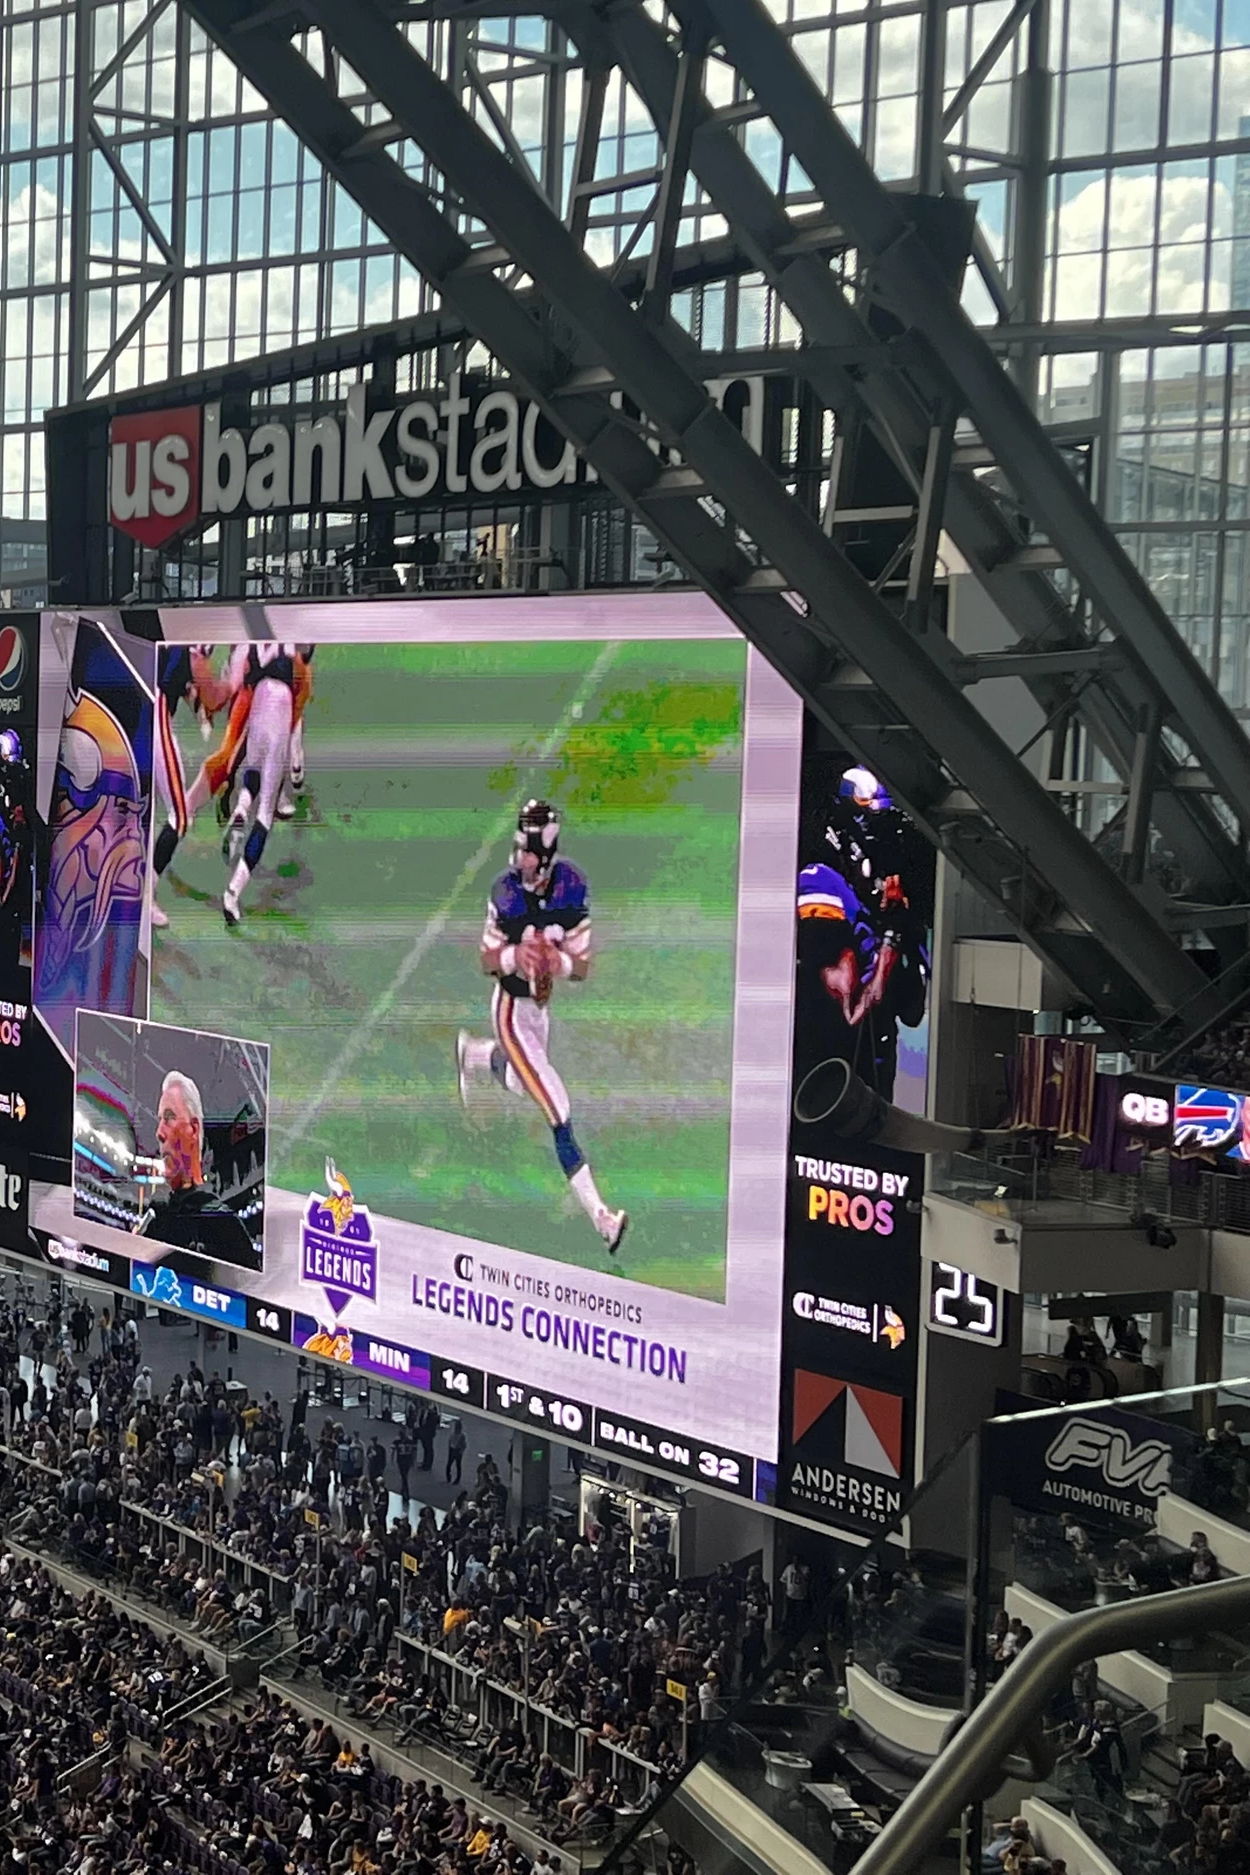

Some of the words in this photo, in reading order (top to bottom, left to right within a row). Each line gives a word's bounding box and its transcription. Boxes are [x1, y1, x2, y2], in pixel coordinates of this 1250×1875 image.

[15, 1003, 28, 1021] BY
[1122, 1093, 1169, 1124] QB
[795, 1155, 878, 1191] TRUSTED
[882, 1172, 909, 1197] BY
[808, 1185, 894, 1236] PROS
[306, 1246, 372, 1291] LEGENDS
[193, 1285, 231, 1313] DET
[257, 1308, 280, 1331] 14
[480, 1264, 509, 1287] TWIN
[514, 1274, 550, 1298] CITIES
[554, 1285, 642, 1324] ORTHOPEDICS
[818, 1297, 840, 1312] TWIN
[841, 1302, 867, 1319] CITIES
[935, 1261, 993, 1333] 25
[412, 1274, 514, 1332] LEGENDS
[521, 1305, 687, 1384] CONNECTION
[814, 1309, 871, 1334] ORTHOPEDICS
[369, 1342, 410, 1373] MIN
[442, 1368, 469, 1394] 14
[528, 1396, 545, 1417] &
[549, 1400, 584, 1431] 10
[600, 1421, 654, 1454] BALL
[659, 1441, 689, 1465] ON
[699, 1451, 740, 1484] 32
[791, 1463, 901, 1512] ANDERSEN
[791, 1486, 843, 1510] WINDOWS
[1042, 1480, 1131, 1516] AUTOMOTIVE
